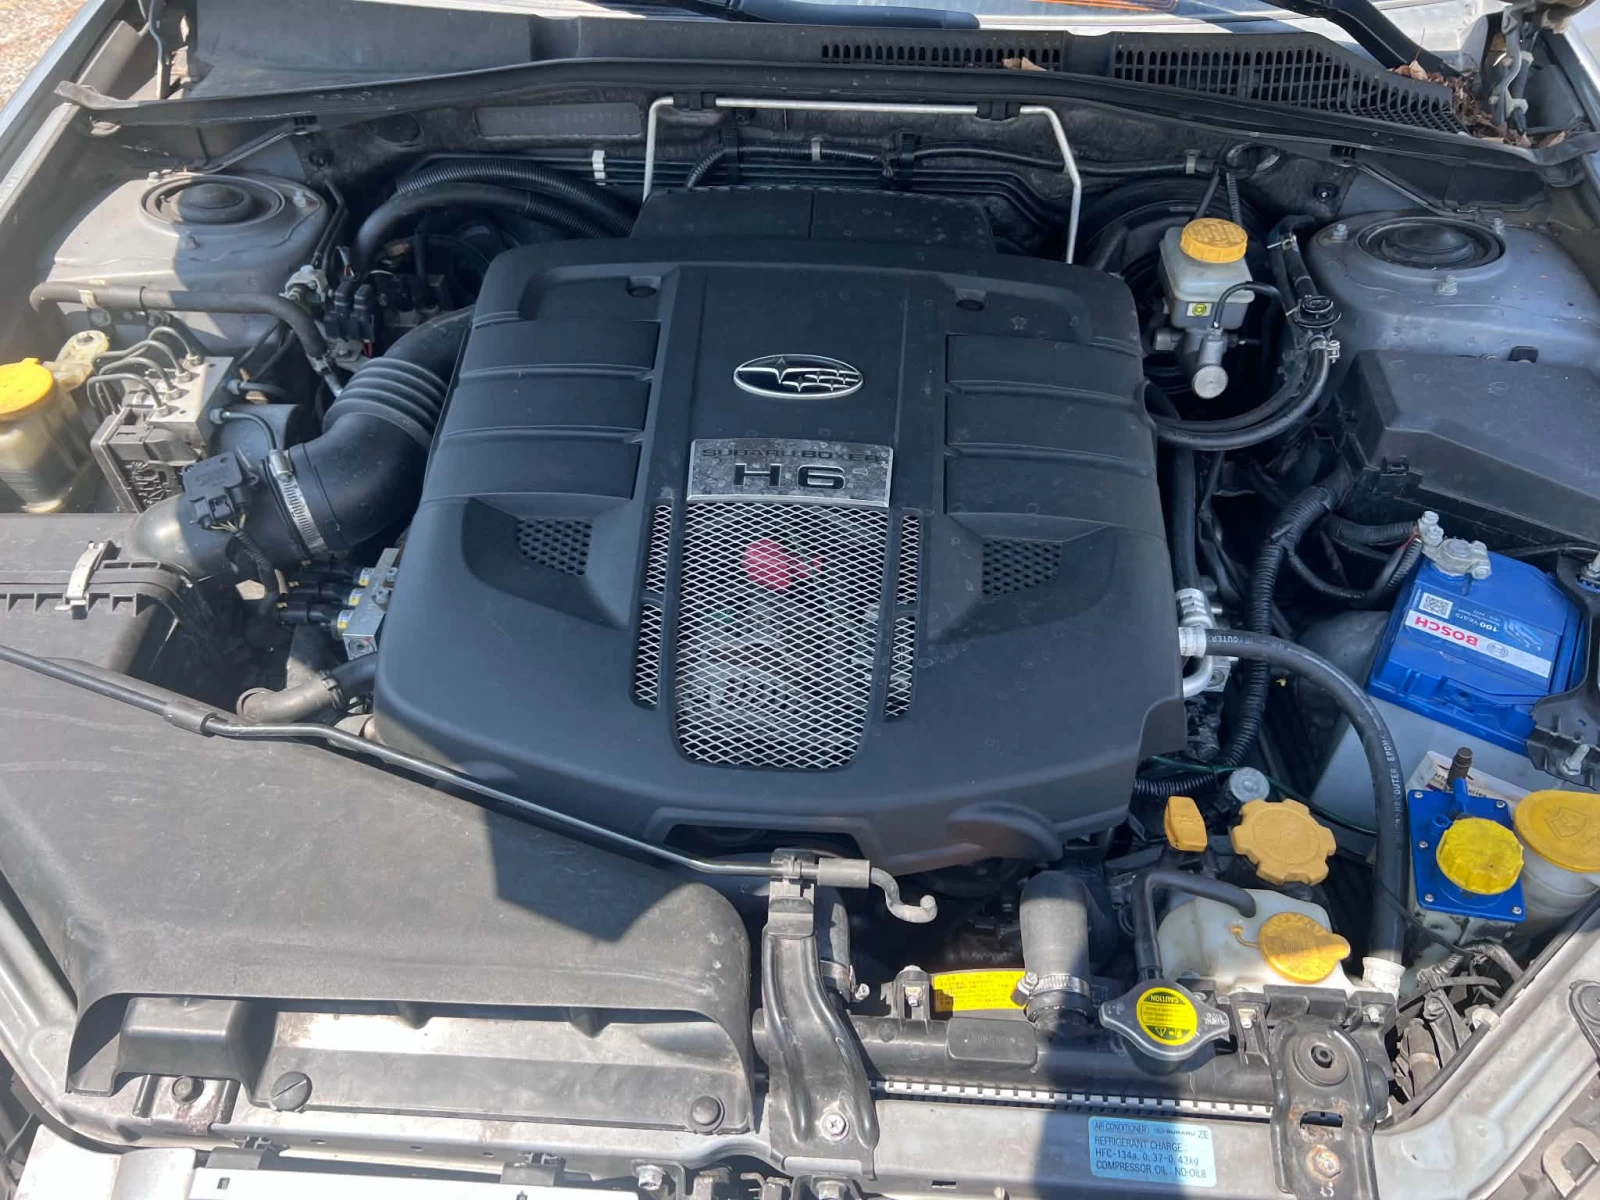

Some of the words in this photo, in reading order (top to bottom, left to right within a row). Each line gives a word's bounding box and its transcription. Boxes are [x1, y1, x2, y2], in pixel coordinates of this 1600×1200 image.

[702, 449, 796, 458] SUBARU
[1414, 615, 1480, 648] BOSCH
[1479, 621, 1500, 633] 100
[1150, 994, 1180, 1005] CAUTION
[1094, 1136, 1149, 1149] REFRIGERANT
[1096, 1159, 1152, 1174] COMPRESSOR
